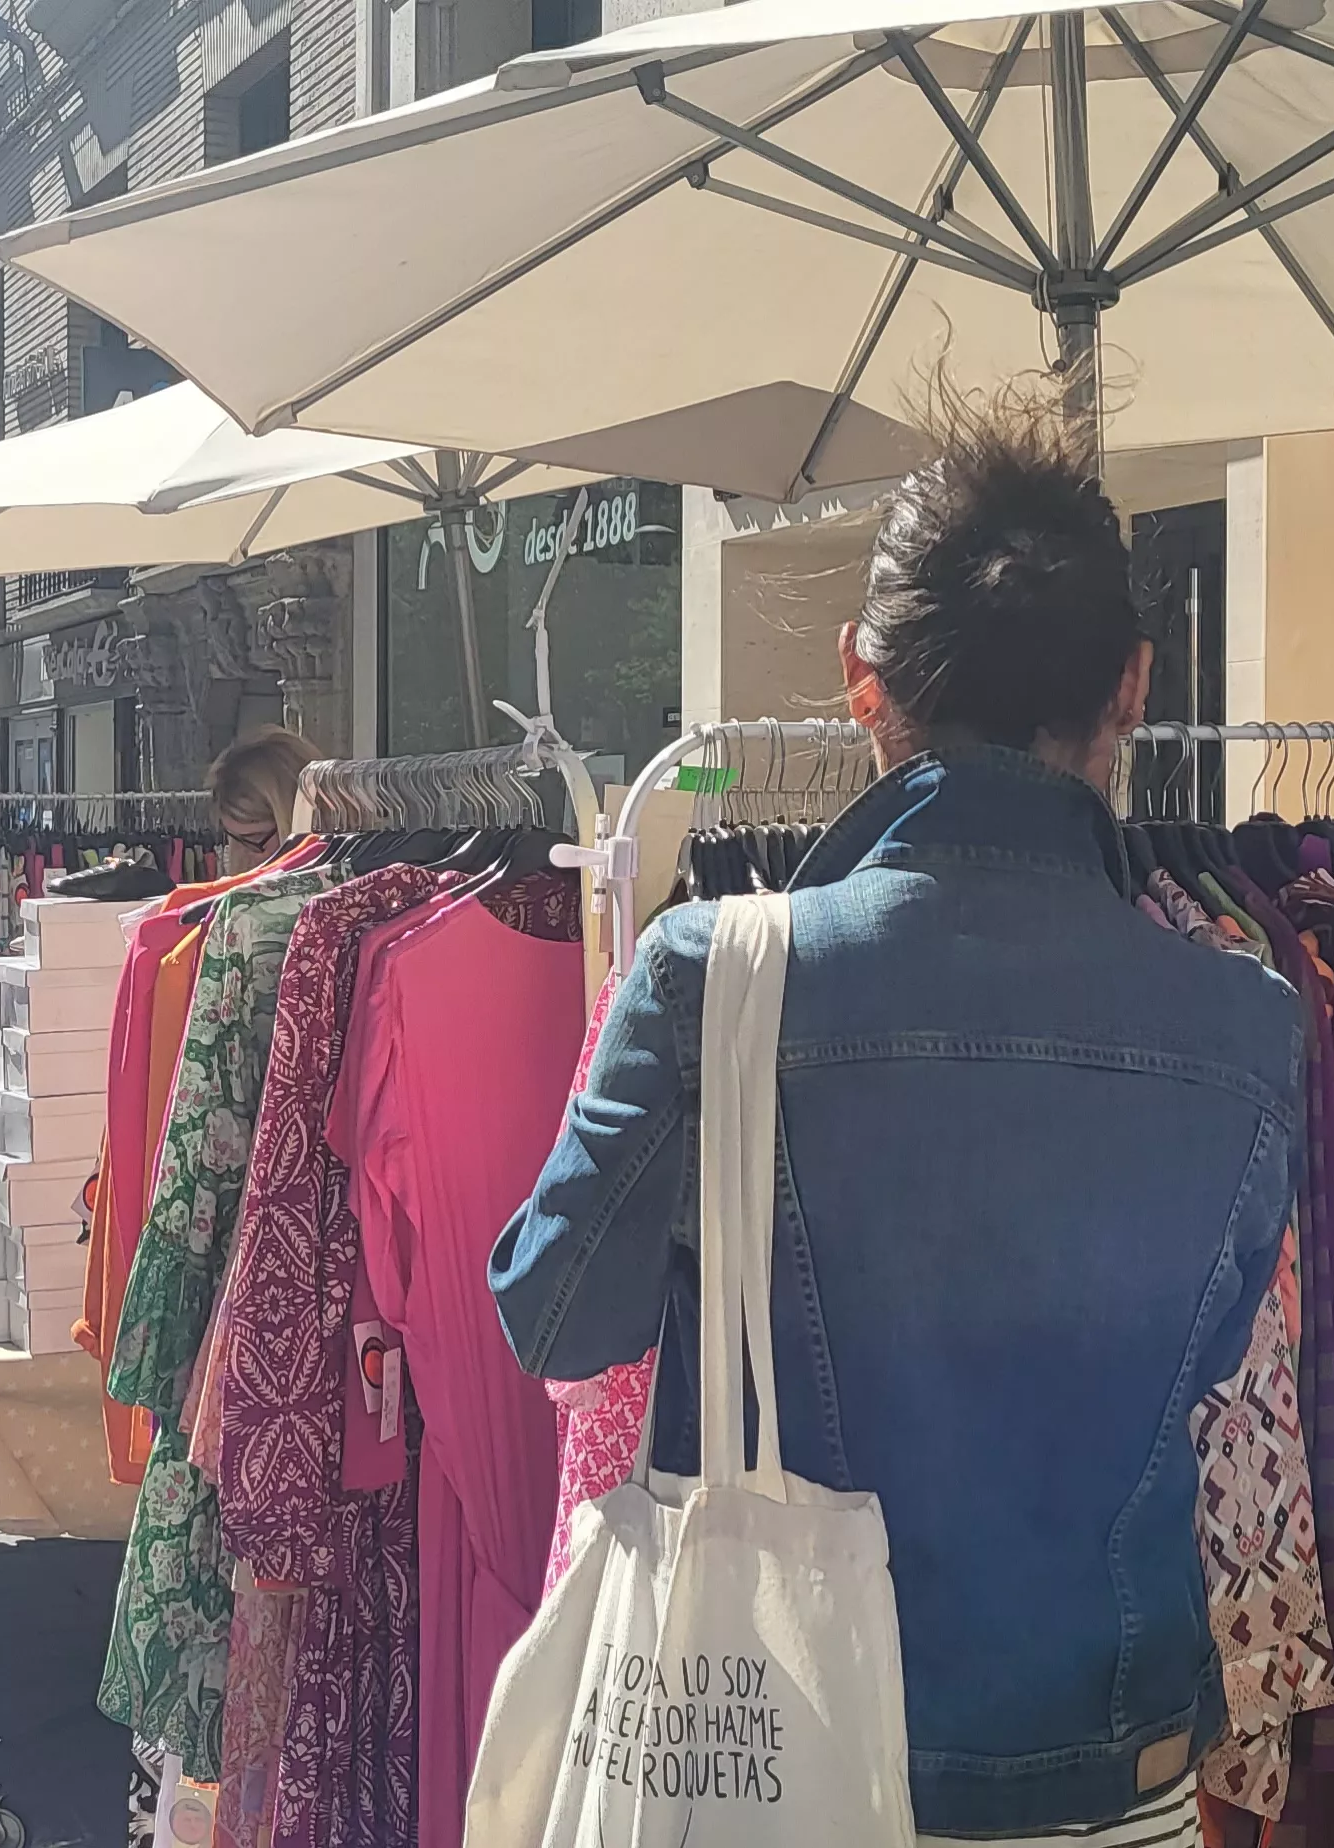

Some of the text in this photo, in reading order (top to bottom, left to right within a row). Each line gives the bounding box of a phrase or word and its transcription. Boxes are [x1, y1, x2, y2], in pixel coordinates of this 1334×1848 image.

[583, 491, 637, 552] 1888
[681, 1653, 710, 1698] LO
[722, 1655, 768, 1700] SOY.
[705, 1703, 784, 1751] HAZME
[642, 1749, 783, 1803] ROQUETAS
